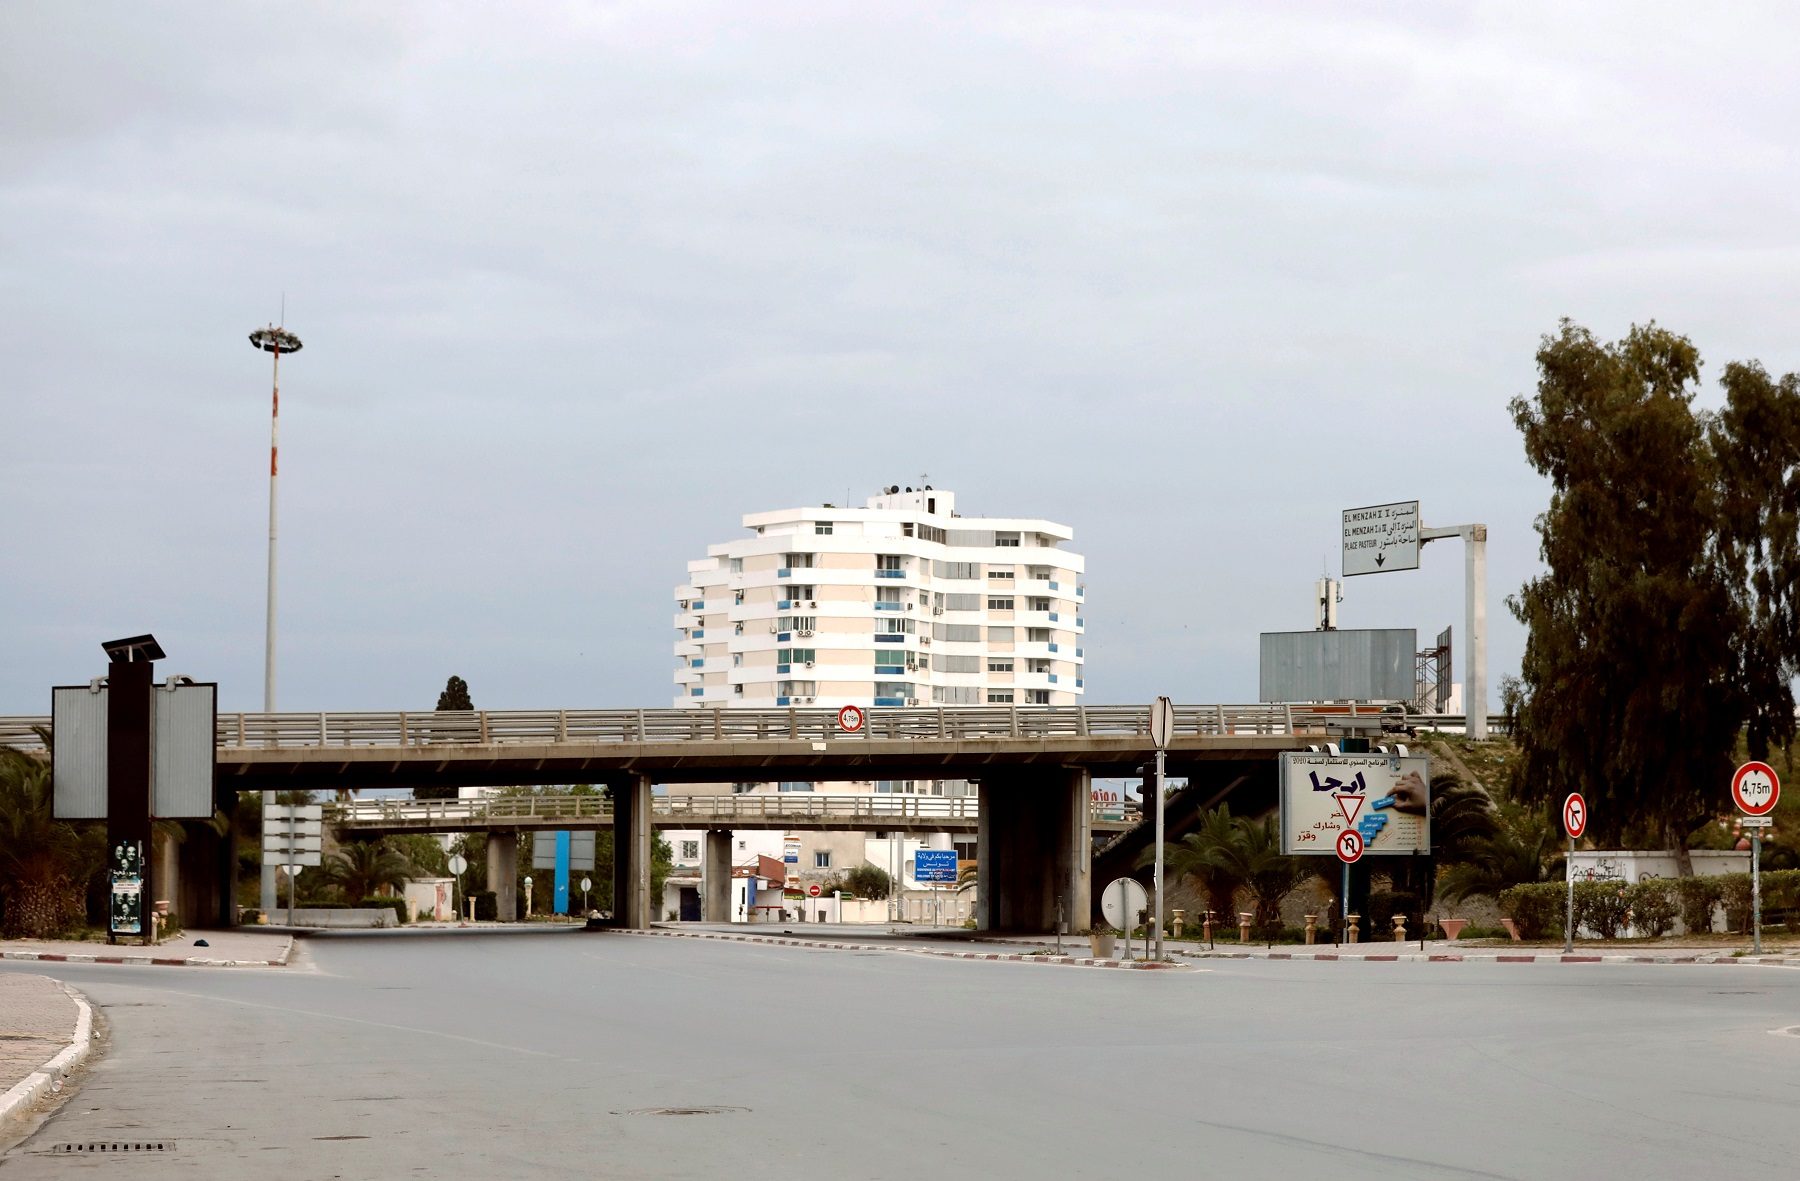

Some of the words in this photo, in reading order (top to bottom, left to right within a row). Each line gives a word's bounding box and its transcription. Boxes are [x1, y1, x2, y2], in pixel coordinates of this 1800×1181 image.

[1344, 514, 1351, 522] EL
[1352, 511, 1376, 522] MENZAH
[1344, 528, 1350, 536] EL
[1352, 526, 1374, 536] MENZAH
[1398, 534, 1417, 544] ساحة
[1344, 542, 1358, 550] PLACE
[1358, 539, 1377, 549] PASTEUR
[1349, 758, 1368, 768] السنوي
[1742, 780, 1770, 797] 4,75m
[1312, 821, 1341, 831] وشارك
